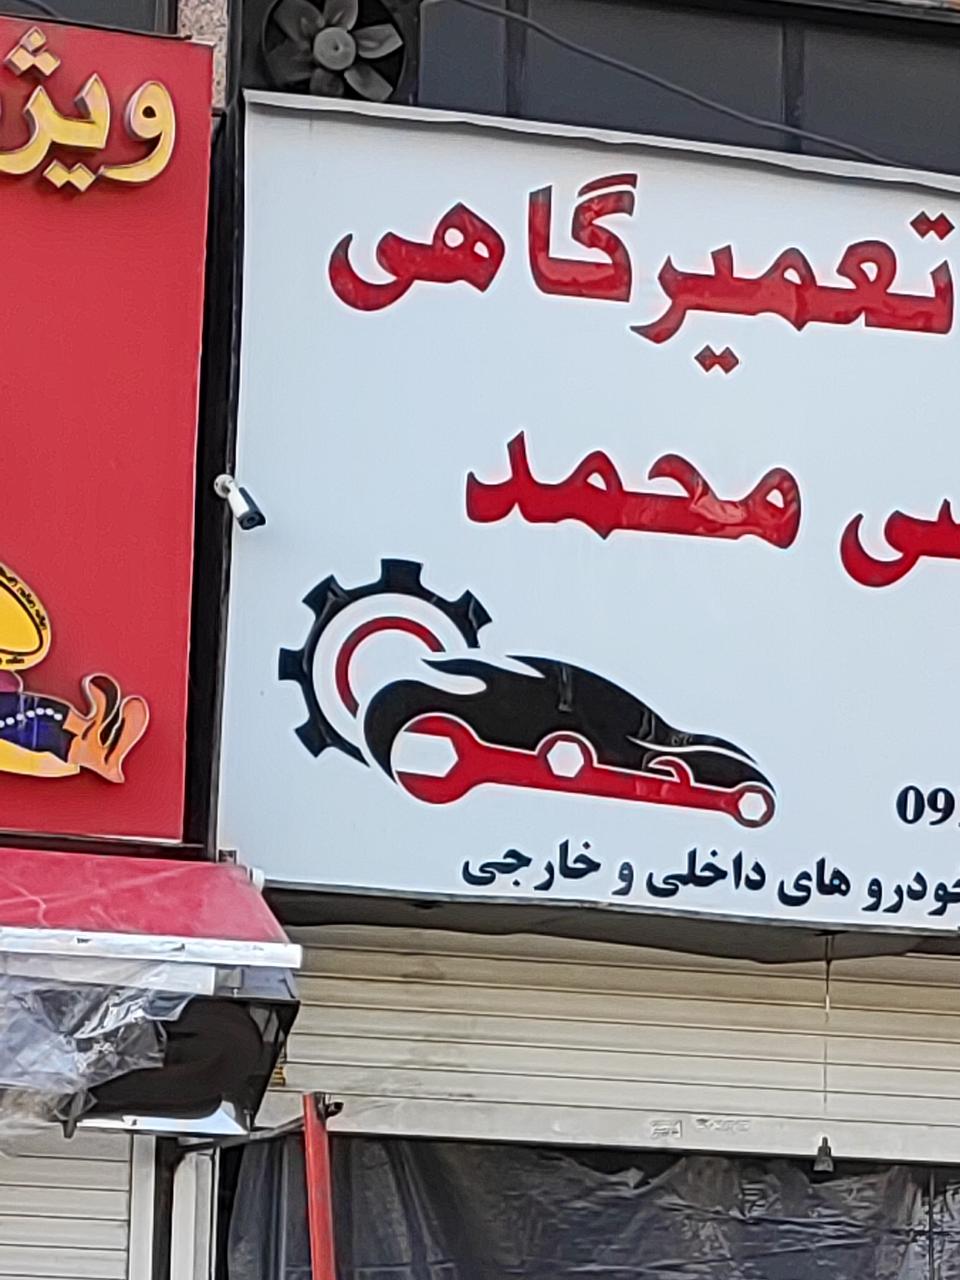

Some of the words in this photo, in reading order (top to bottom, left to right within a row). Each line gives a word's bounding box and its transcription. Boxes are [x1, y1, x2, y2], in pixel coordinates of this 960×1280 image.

[0, 26, 176, 193] ویژ
[328, 174, 956, 375] تعمیرگاهی
[465, 429, 801, 549] محمد
[462, 839, 602, 890] خارجی
[611, 861, 634, 896] و
[646, 847, 766, 897] داخلی
[778, 856, 852, 907] های
